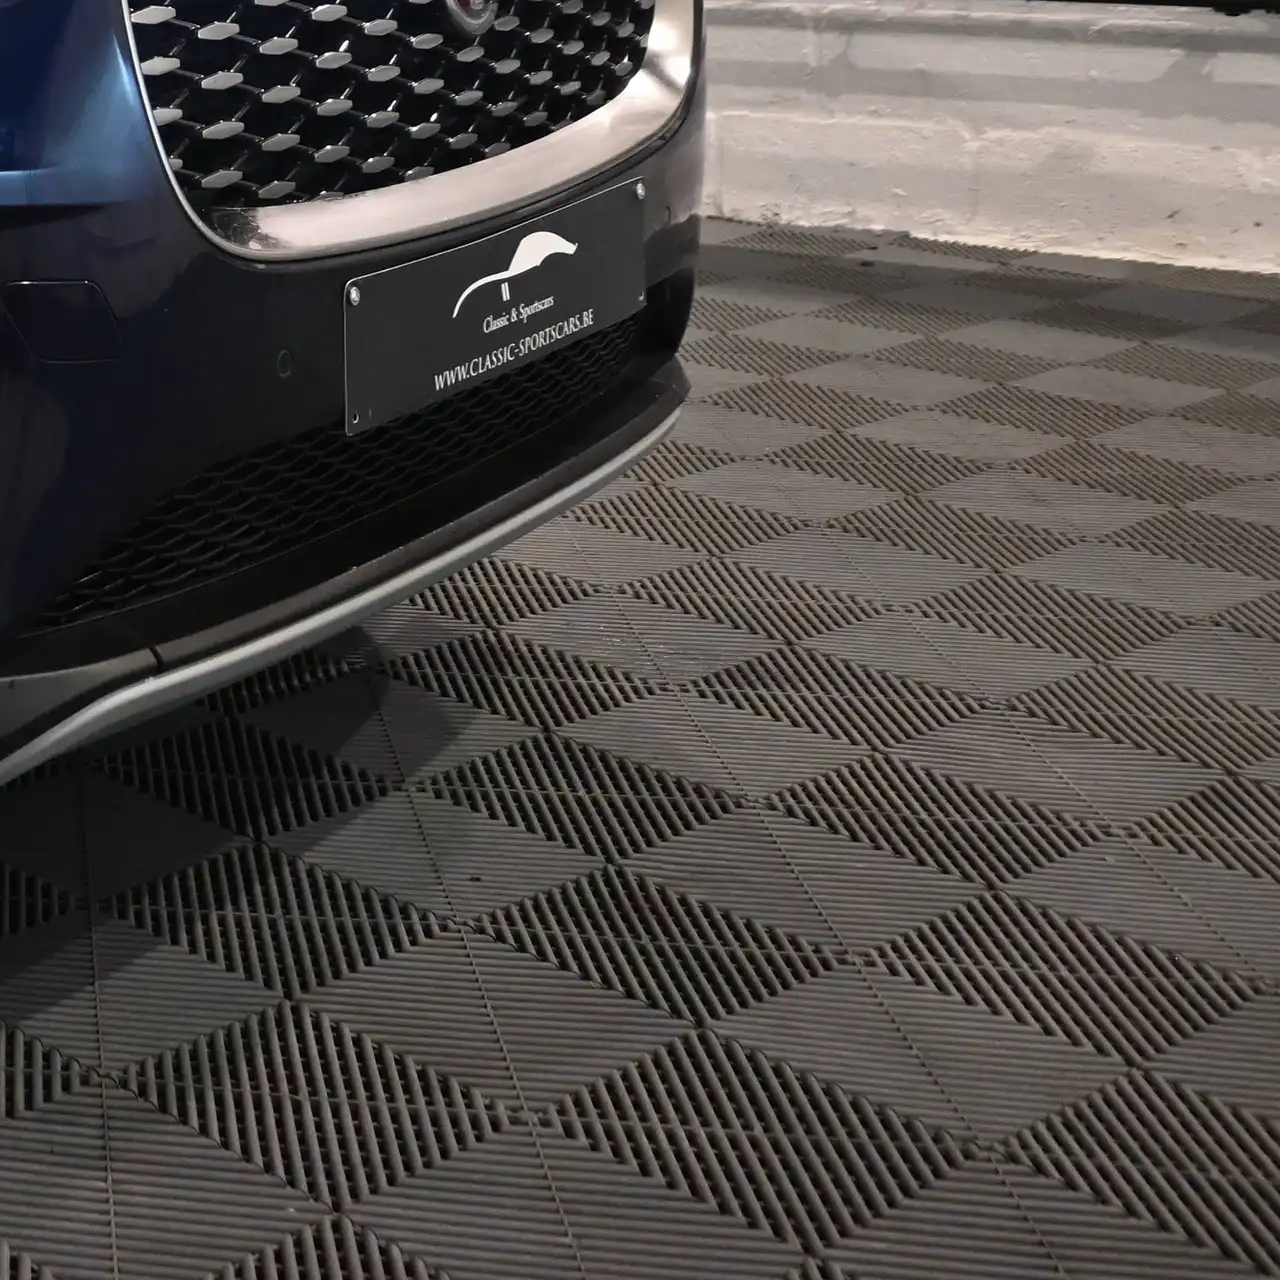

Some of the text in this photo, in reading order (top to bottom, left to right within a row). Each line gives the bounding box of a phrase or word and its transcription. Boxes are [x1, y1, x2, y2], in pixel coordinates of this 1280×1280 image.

[482, 296, 555, 334] Classic & Sportscars
[434, 308, 594, 391] WWW.CLASSIC-SPORTSCARS.BE
